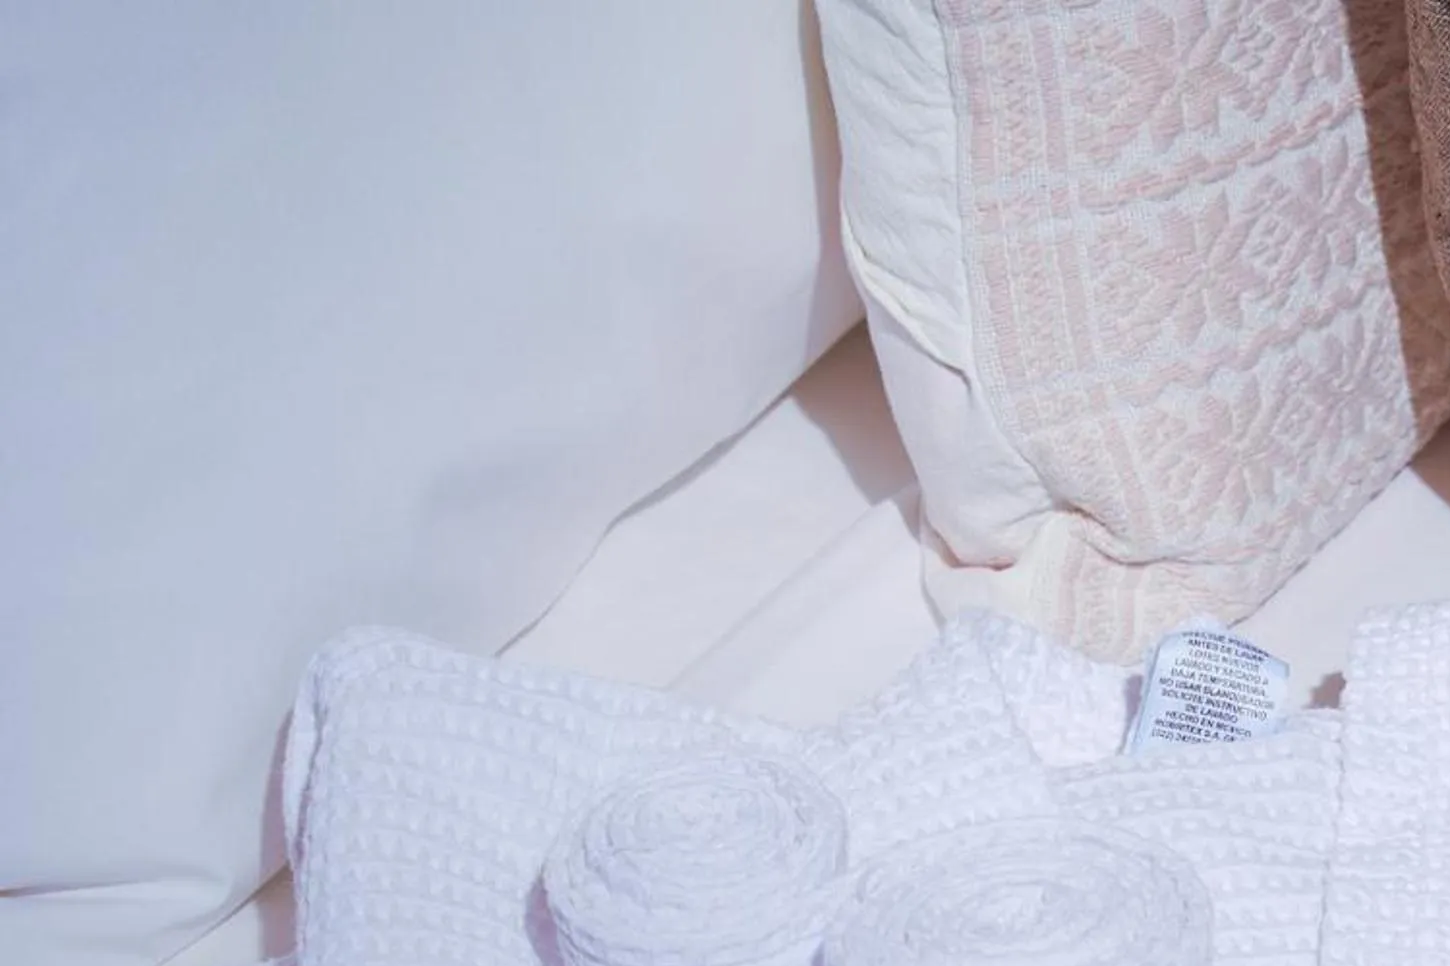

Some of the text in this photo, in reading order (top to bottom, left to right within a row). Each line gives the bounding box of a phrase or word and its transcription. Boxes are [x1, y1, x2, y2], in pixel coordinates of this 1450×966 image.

[1174, 656, 1212, 671] LAVADO
[1170, 667, 1196, 681] BAJA
[1159, 676, 1174, 687] NO
[1175, 680, 1201, 693] USAR
[1165, 710, 1200, 724] HECHO
[1200, 716, 1214, 729] EN
[1185, 703, 1239, 724] DE LAVADO
